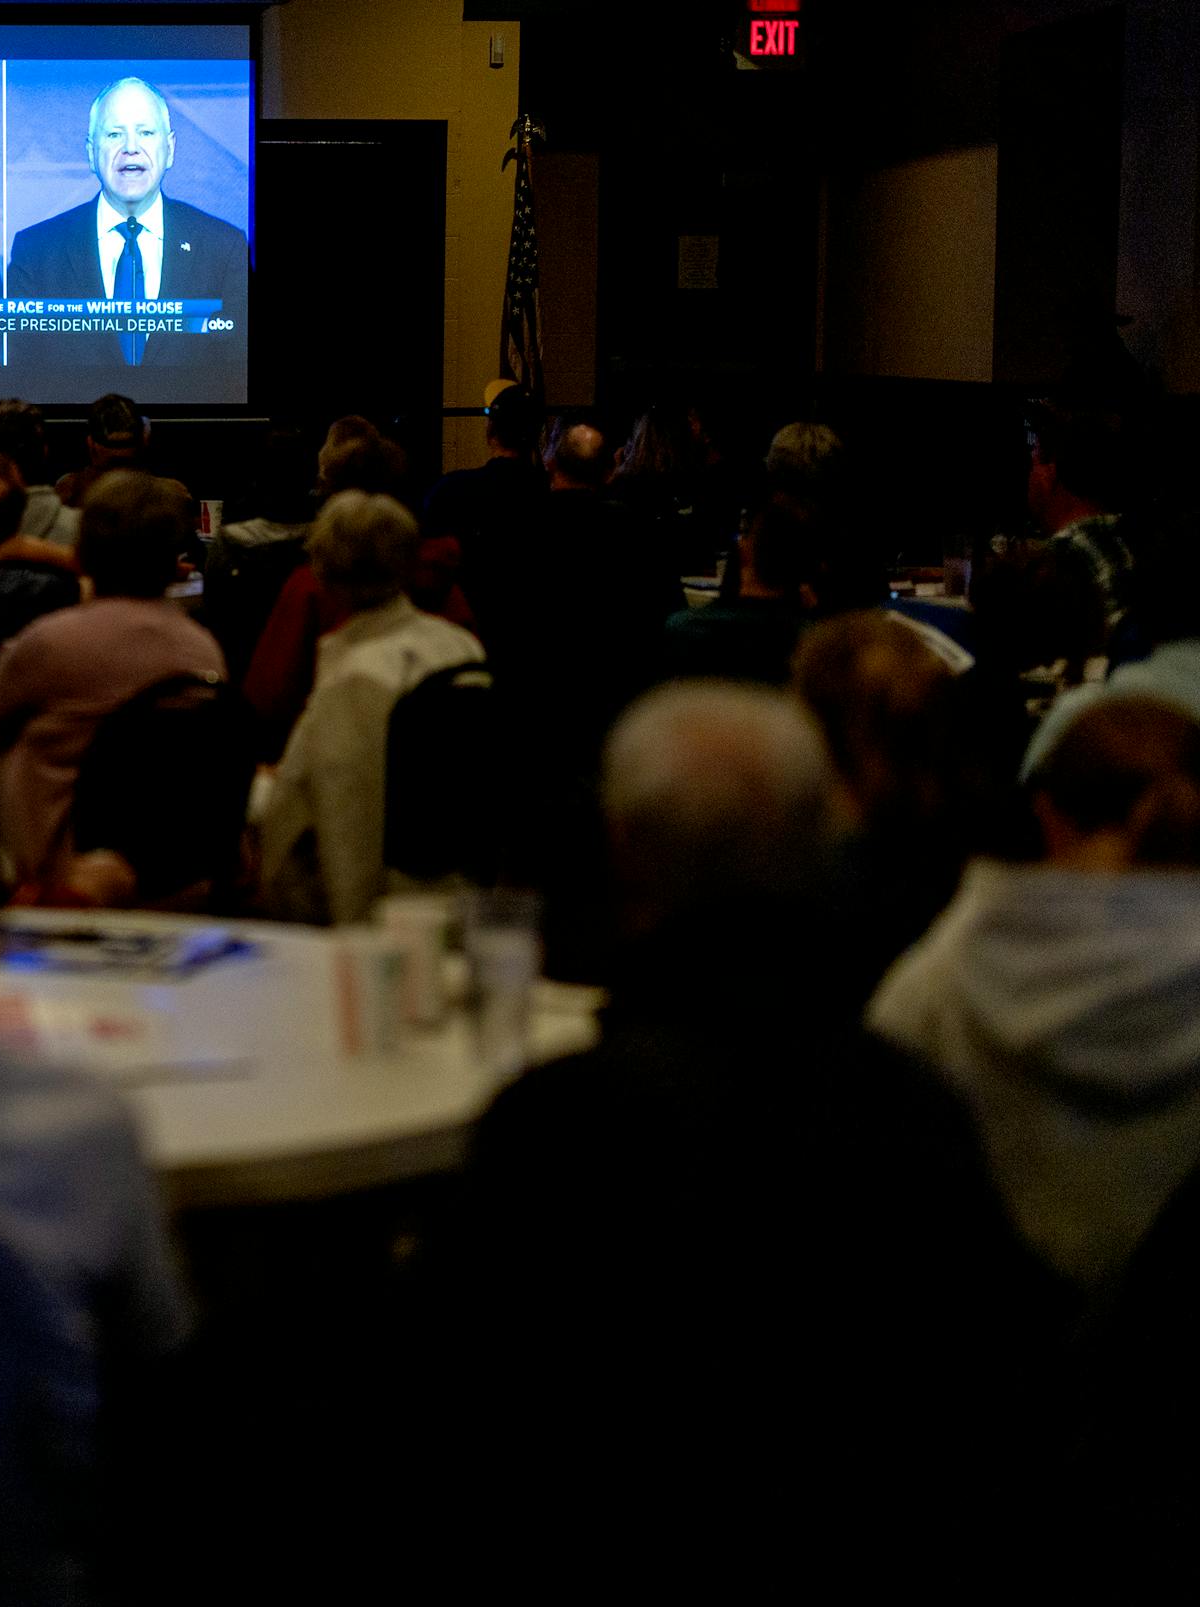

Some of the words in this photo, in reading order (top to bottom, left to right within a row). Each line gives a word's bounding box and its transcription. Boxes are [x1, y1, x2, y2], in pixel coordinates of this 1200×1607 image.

[750, 20, 799, 55] EXIT
[7, 301, 44, 314] RACE
[47, 303, 65, 313] FOR
[66, 303, 83, 312] THE
[86, 301, 132, 314] WHITE
[136, 301, 183, 314] HOUSE
[20, 318, 123, 332] PRESIDENTIAL
[127, 318, 183, 332] DEBATE
[208, 317, 234, 331] abc
